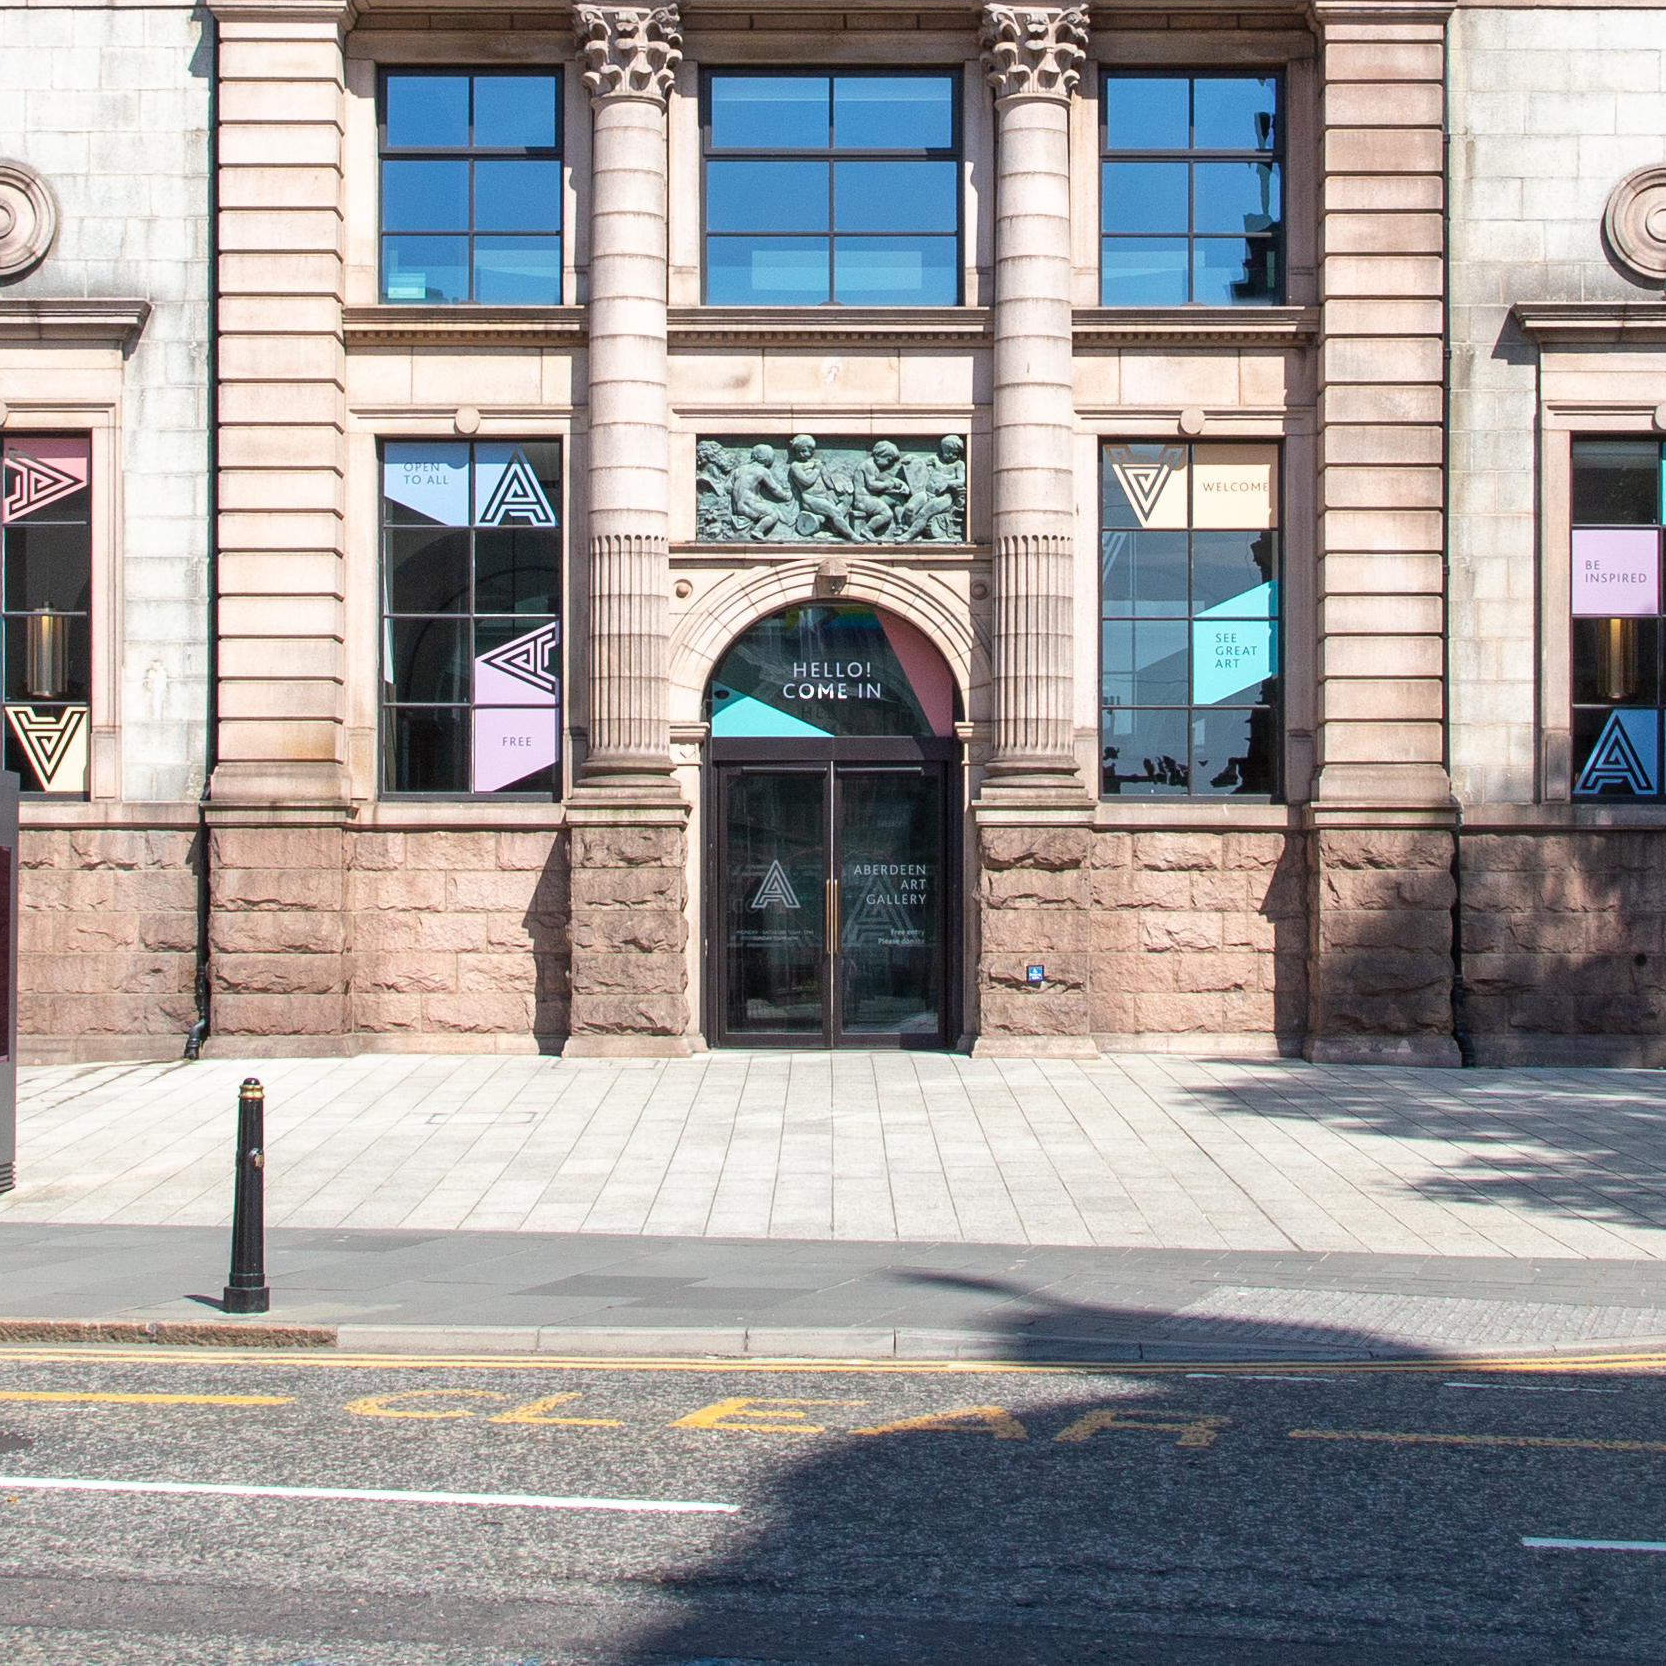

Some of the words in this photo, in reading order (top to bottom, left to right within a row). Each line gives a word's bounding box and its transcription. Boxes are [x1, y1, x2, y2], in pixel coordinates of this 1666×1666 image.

[403, 461, 441, 472] OPEN
[403, 474, 422, 485] TO
[426, 474, 449, 485] ALL
[1202, 481, 1269, 493] WELCOME
[1585, 559, 1601, 571] BE
[1585, 572, 1648, 584] INSPIRED
[1215, 632, 1237, 644] SEE
[1215, 645, 1258, 656] GREAT
[792, 661, 872, 678] HELLO!
[1215, 658, 1241, 669] ART
[783, 682, 849, 699] COME
[858, 682, 881, 699] IN
[502, 736, 532, 747] FREE
[853, 864, 927, 876] ABERDEEN
[900, 879, 927, 890] ART
[866, 893, 927, 905] GALLERY
[343, 1388, 1233, 1447] CLEAR
